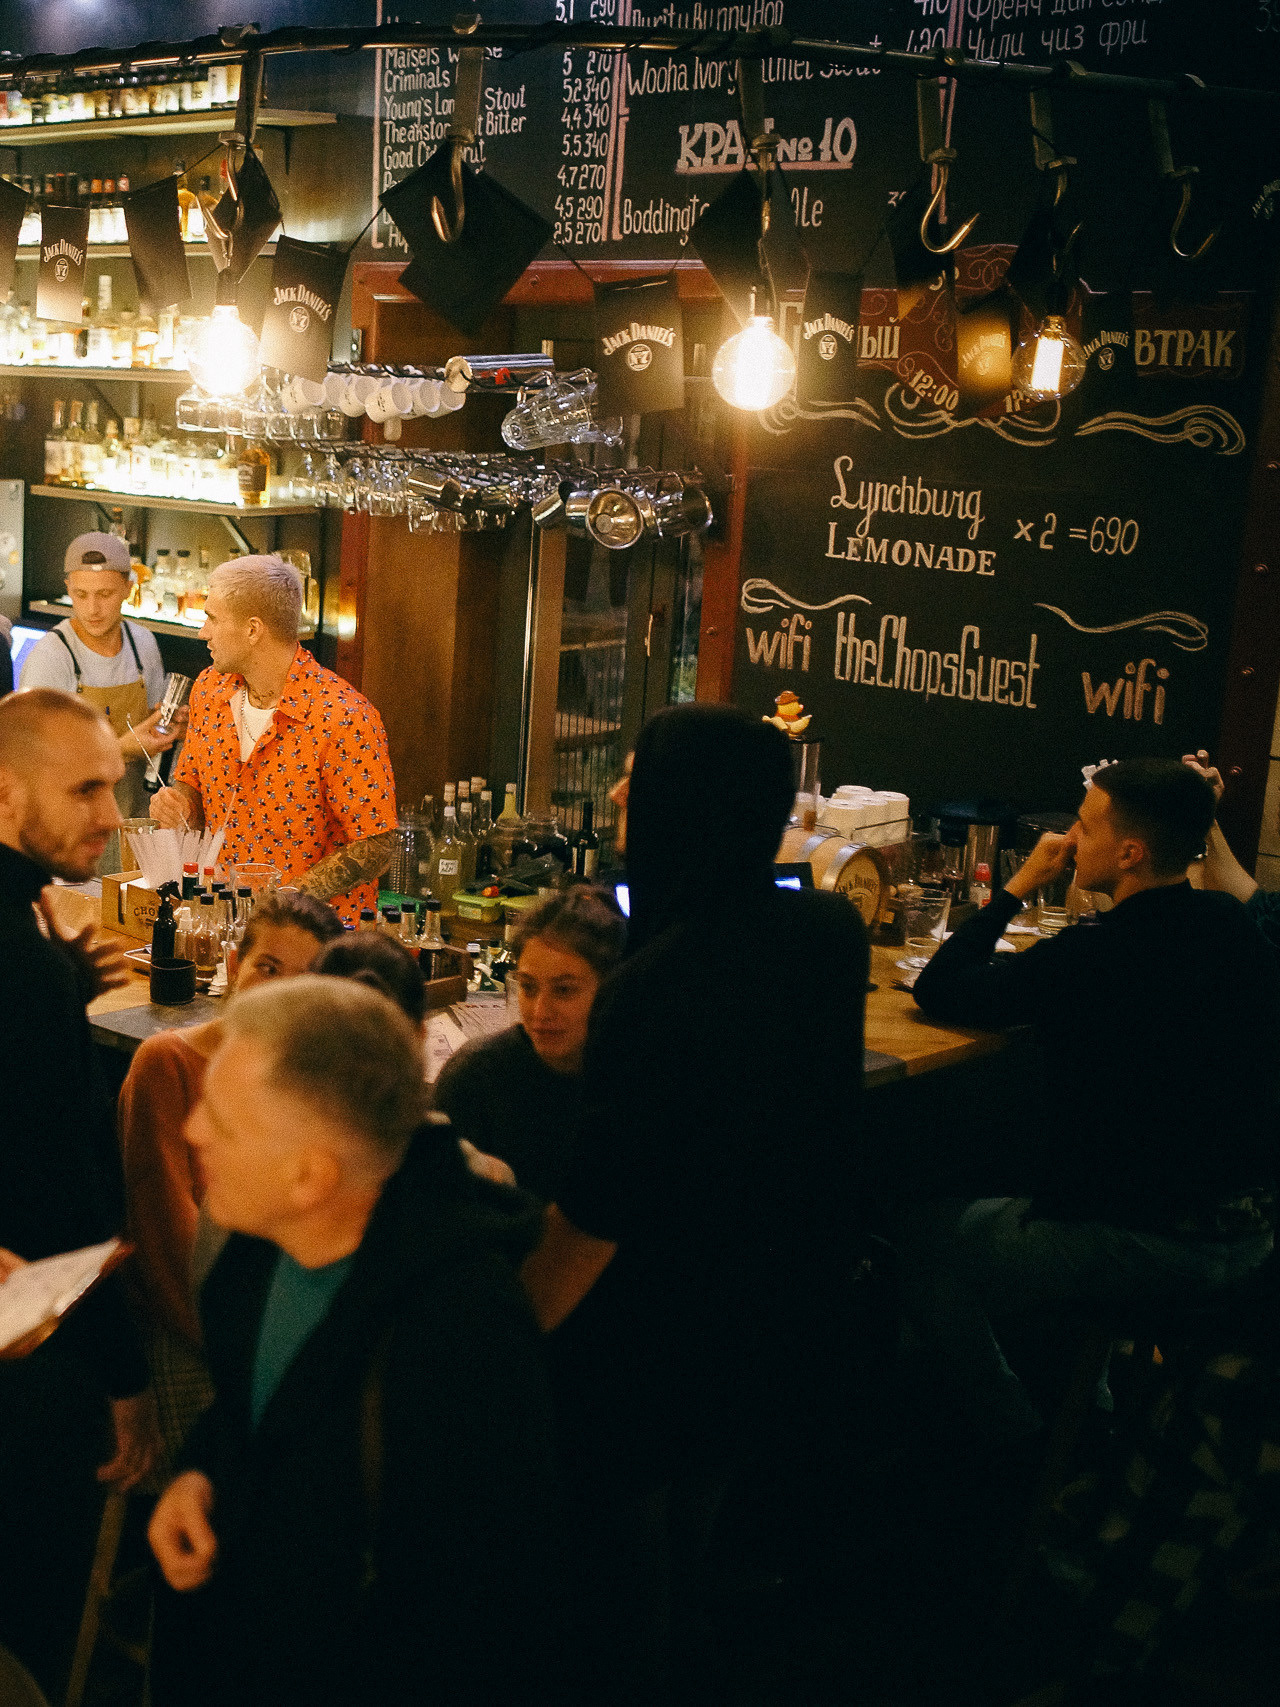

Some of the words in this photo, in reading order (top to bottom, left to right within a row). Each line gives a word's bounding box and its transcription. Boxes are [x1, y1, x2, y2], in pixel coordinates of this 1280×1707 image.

[383, 69, 451, 93] Criminals
[484, 84, 526, 111] Stout
[486, 111, 526, 137] Bitter
[819, 117, 858, 164] 10
[622, 195, 710, 246] Boddingt
[1134, 328, 1237, 368] ВТРАК
[829, 455, 986, 541] Lynchburg
[825, 521, 997, 577] LEMONADE
[745, 612, 813, 672] wifi
[1081, 657, 1170, 725] wifi
